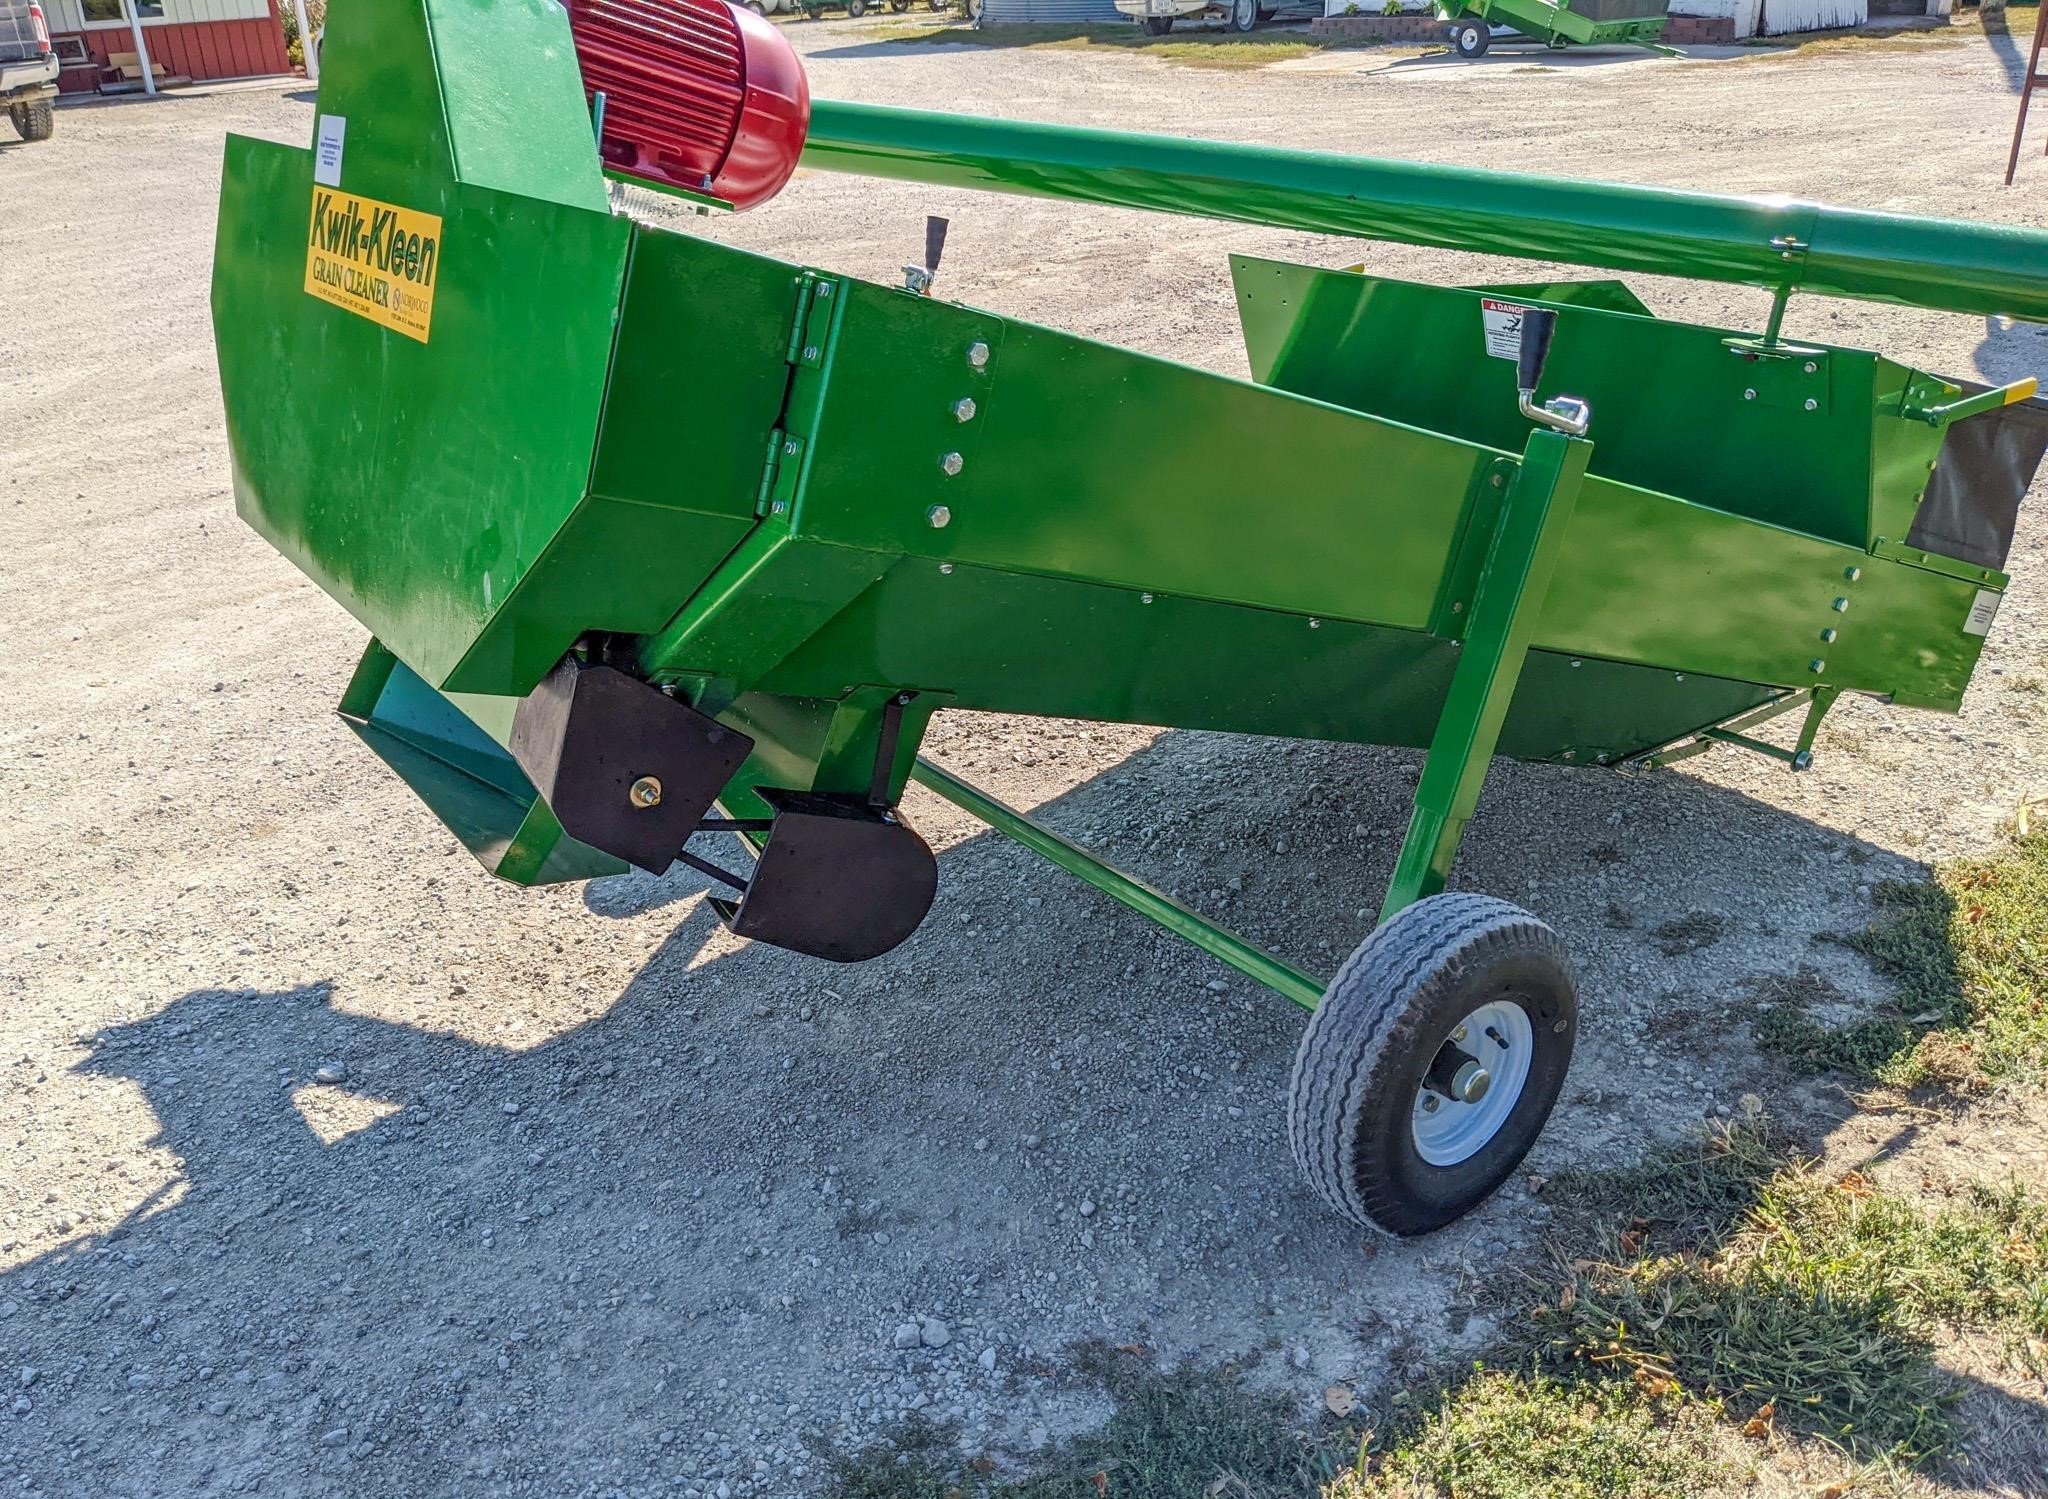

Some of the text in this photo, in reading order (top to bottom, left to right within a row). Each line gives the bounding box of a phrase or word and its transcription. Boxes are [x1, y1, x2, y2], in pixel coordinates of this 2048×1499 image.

[311, 192, 436, 287] Kwik-Kleen
[313, 256, 343, 289] GRAIN
[344, 267, 389, 308] CLEANER
[1497, 303, 1524, 314] DANG
